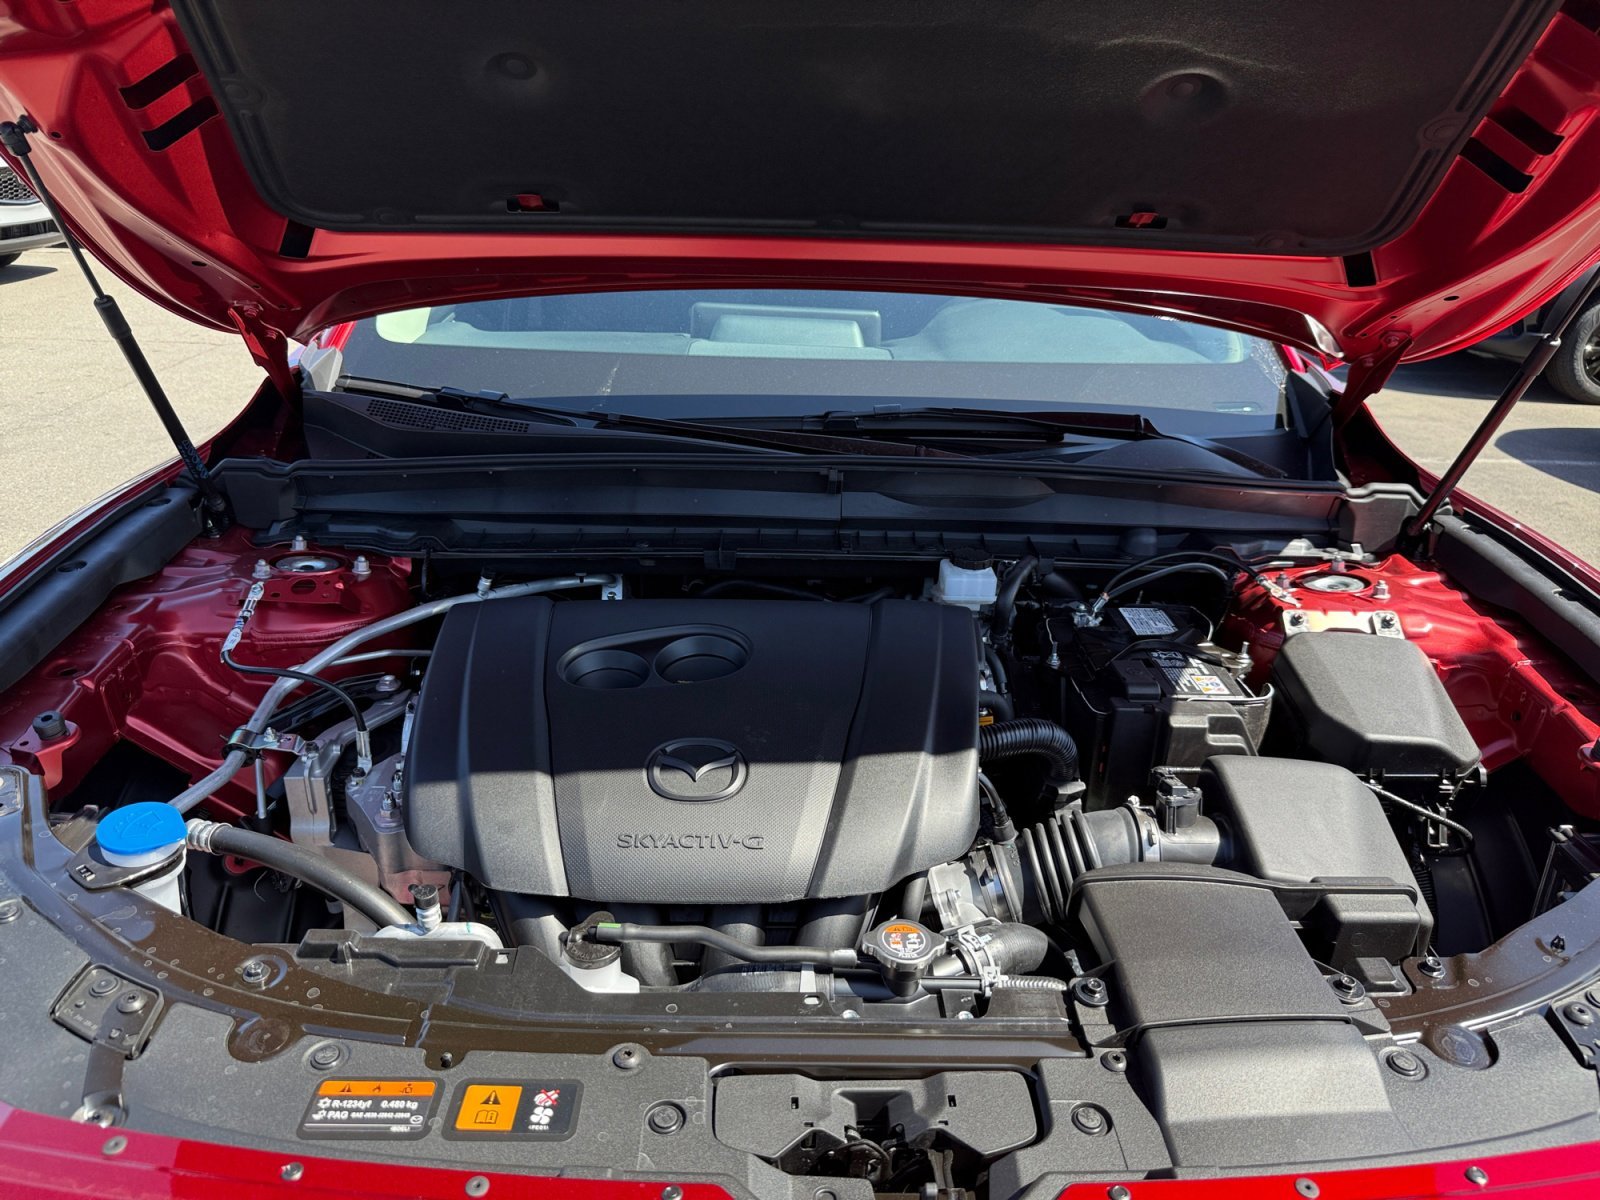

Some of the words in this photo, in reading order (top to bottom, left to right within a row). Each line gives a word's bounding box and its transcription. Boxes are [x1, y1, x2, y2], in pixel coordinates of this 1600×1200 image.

[616, 833, 764, 850] SKYACTIV-G
[331, 1099, 372, 1109] R-1234yf
[406, 1100, 418, 1110] kg
[327, 1110, 349, 1119] PAG
